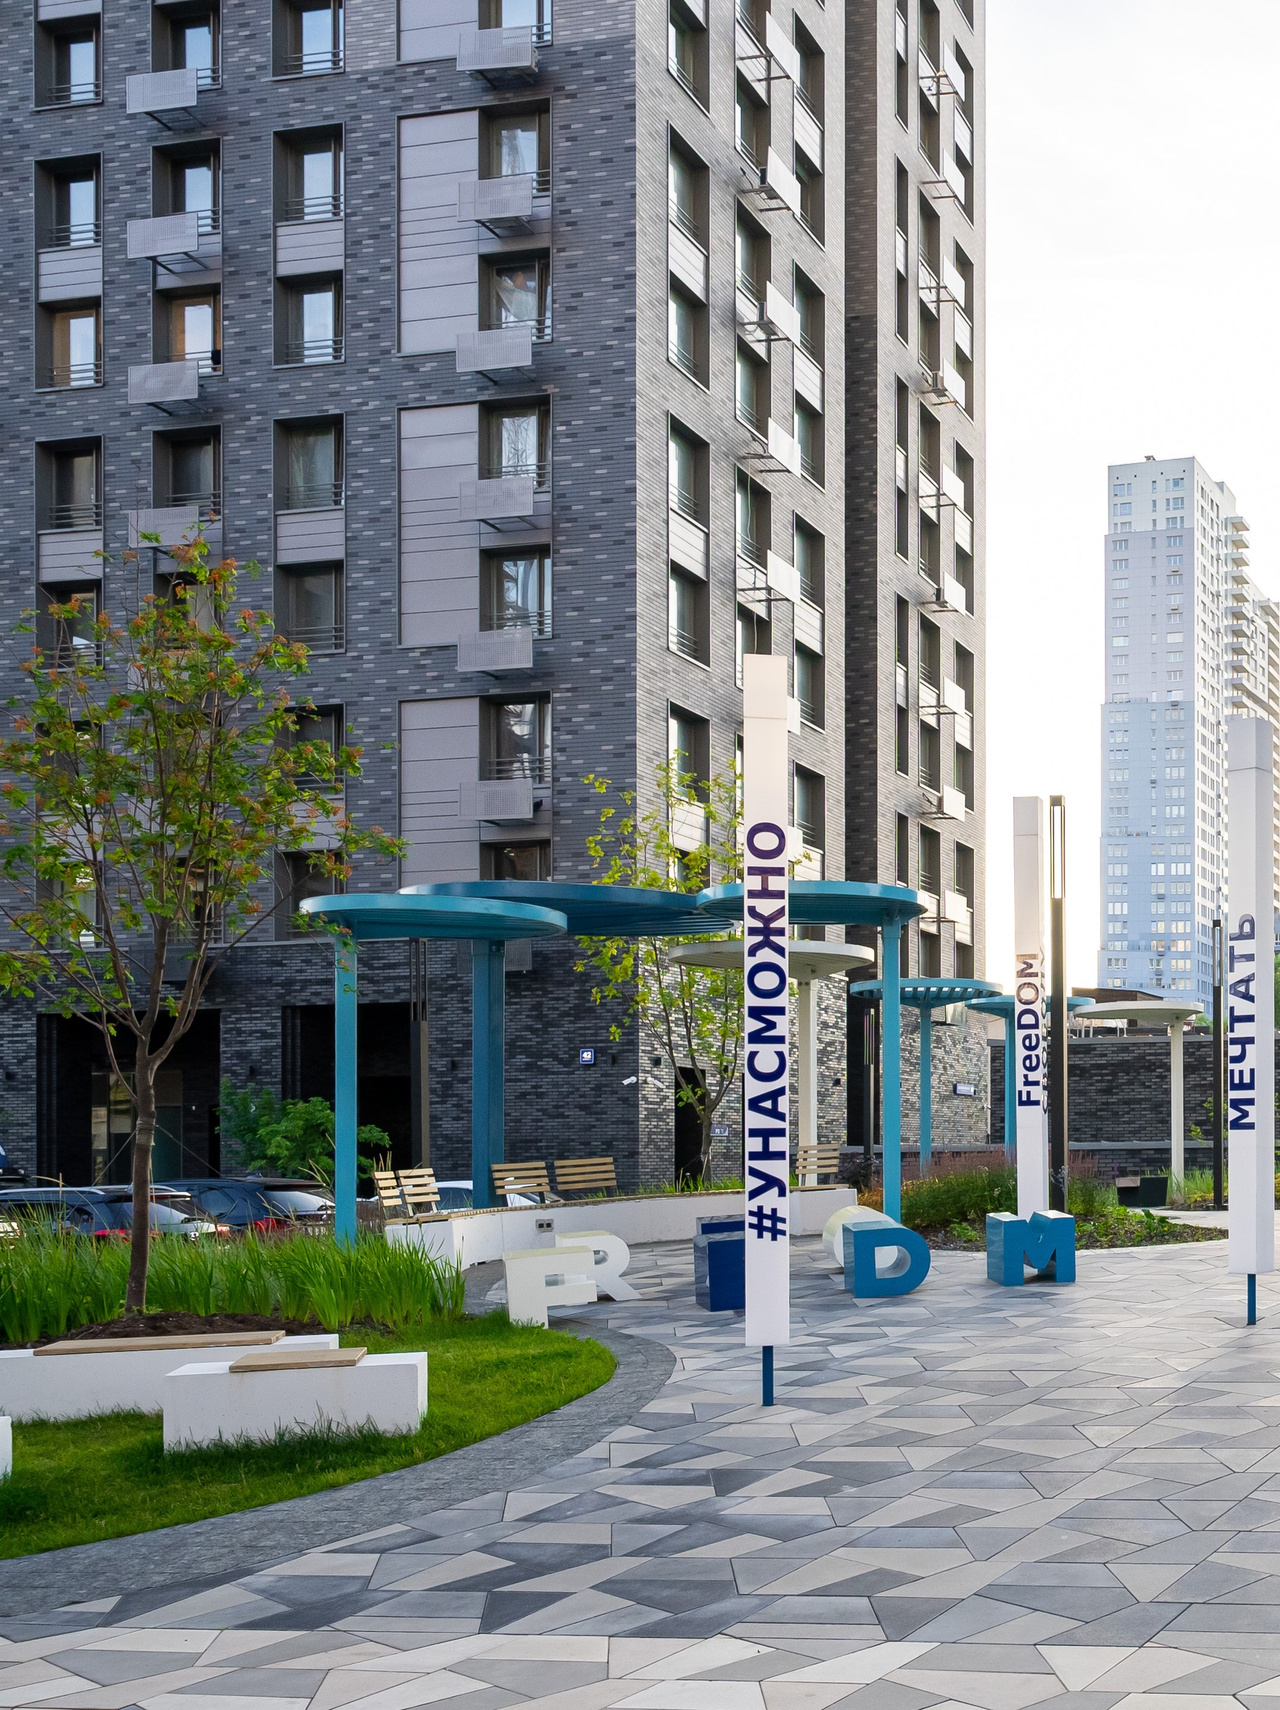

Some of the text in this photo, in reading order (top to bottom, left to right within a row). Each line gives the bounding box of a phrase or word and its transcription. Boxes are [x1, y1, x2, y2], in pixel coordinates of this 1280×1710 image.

[747, 822, 787, 1242] #УНАСМОЖНО
[1016, 954, 1041, 1107] FreeDOM
[1230, 913, 1255, 1131] МЕЧТАТЬ
[842, 1220, 931, 1298] D
[986, 1210, 1076, 1287] M
